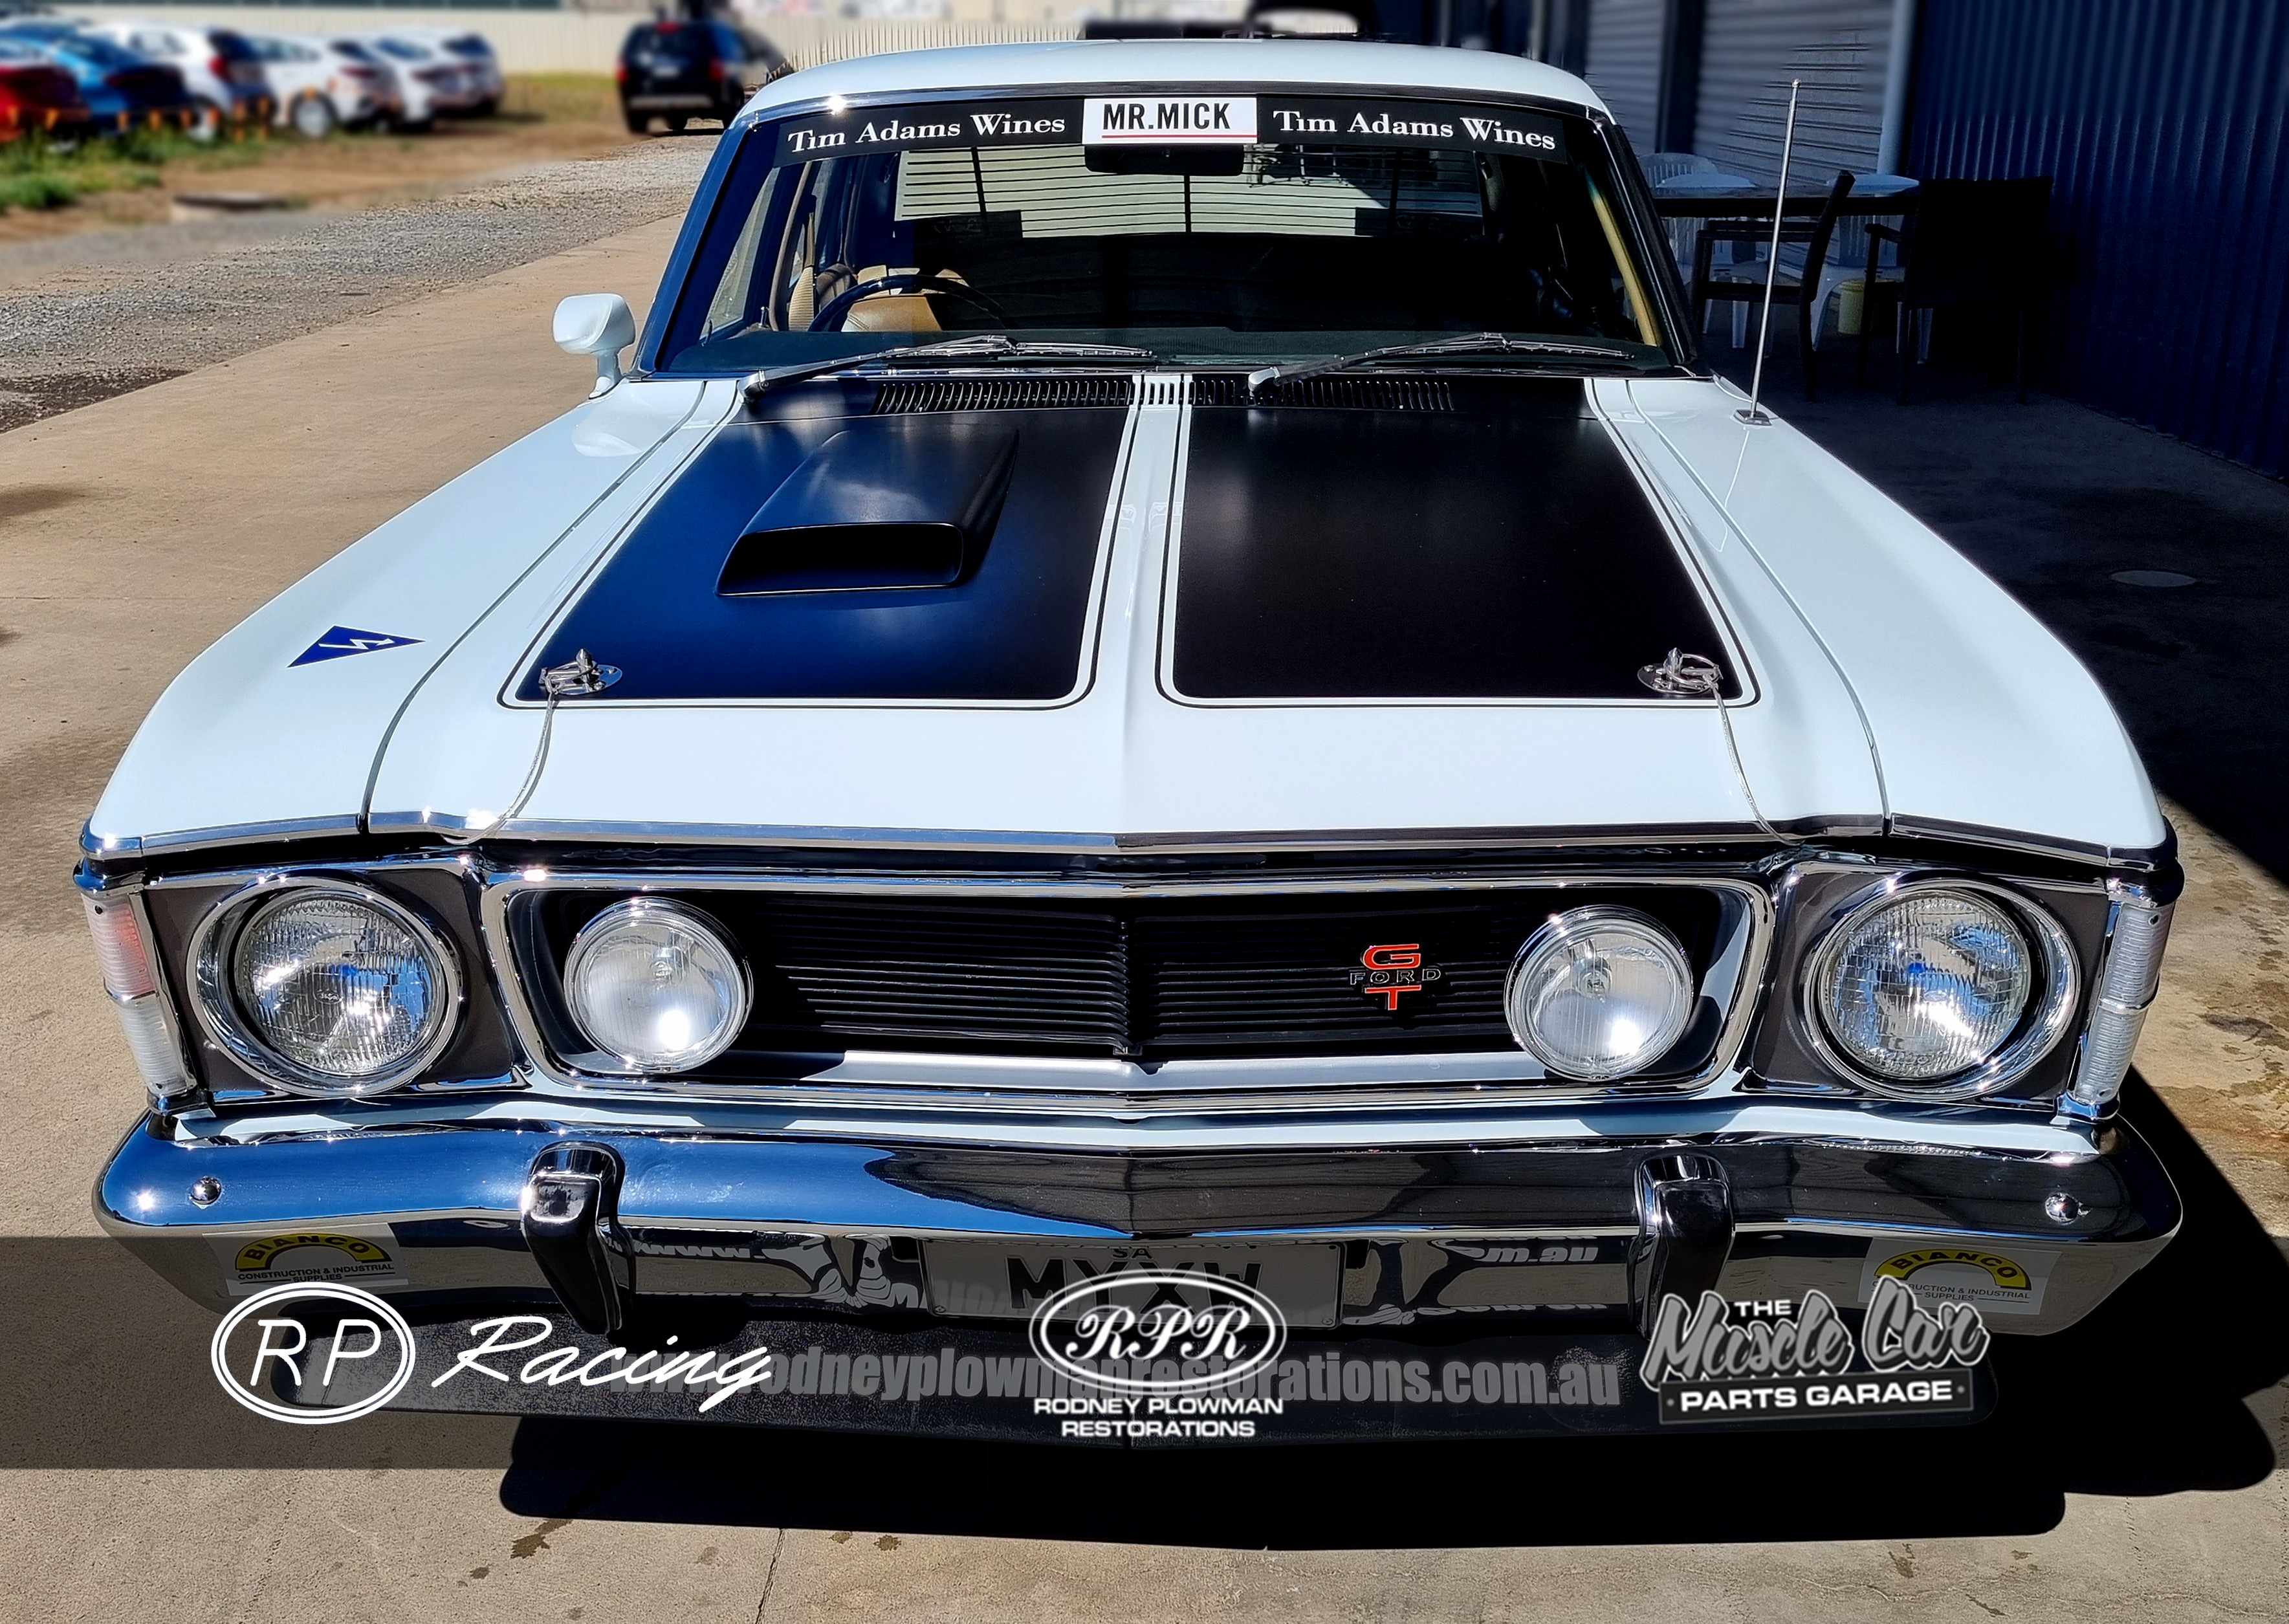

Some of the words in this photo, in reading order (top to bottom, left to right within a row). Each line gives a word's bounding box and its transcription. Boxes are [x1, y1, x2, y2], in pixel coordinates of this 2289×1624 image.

[1102, 102, 1231, 130] MR.MICK
[787, 130, 846, 153] Tim
[854, 120, 961, 144] Adams
[970, 113, 1066, 136] Wines
[1273, 110, 1337, 132] Tim
[1347, 113, 1454, 138] Adams
[1460, 117, 1555, 150] Wines
[1350, 968, 1441, 985] FORD
[243, 1236, 370, 1260] BIANCO
[1113, 1248, 1152, 1258] SA
[238, 1269, 321, 1280] CONSTRUCTION
[333, 1263, 394, 1273] INDUSTRIAL
[1891, 1252, 2017, 1278] BIANCO
[293, 1273, 342, 1282] SUPPLIES
[1924, 1291, 1974, 1301] SUPPLIES
[1968, 1288, 2030, 1299] INDUSTRIAL
[610, 1346, 1621, 1405] wwwrodneyplowmanrestorations.com.au
